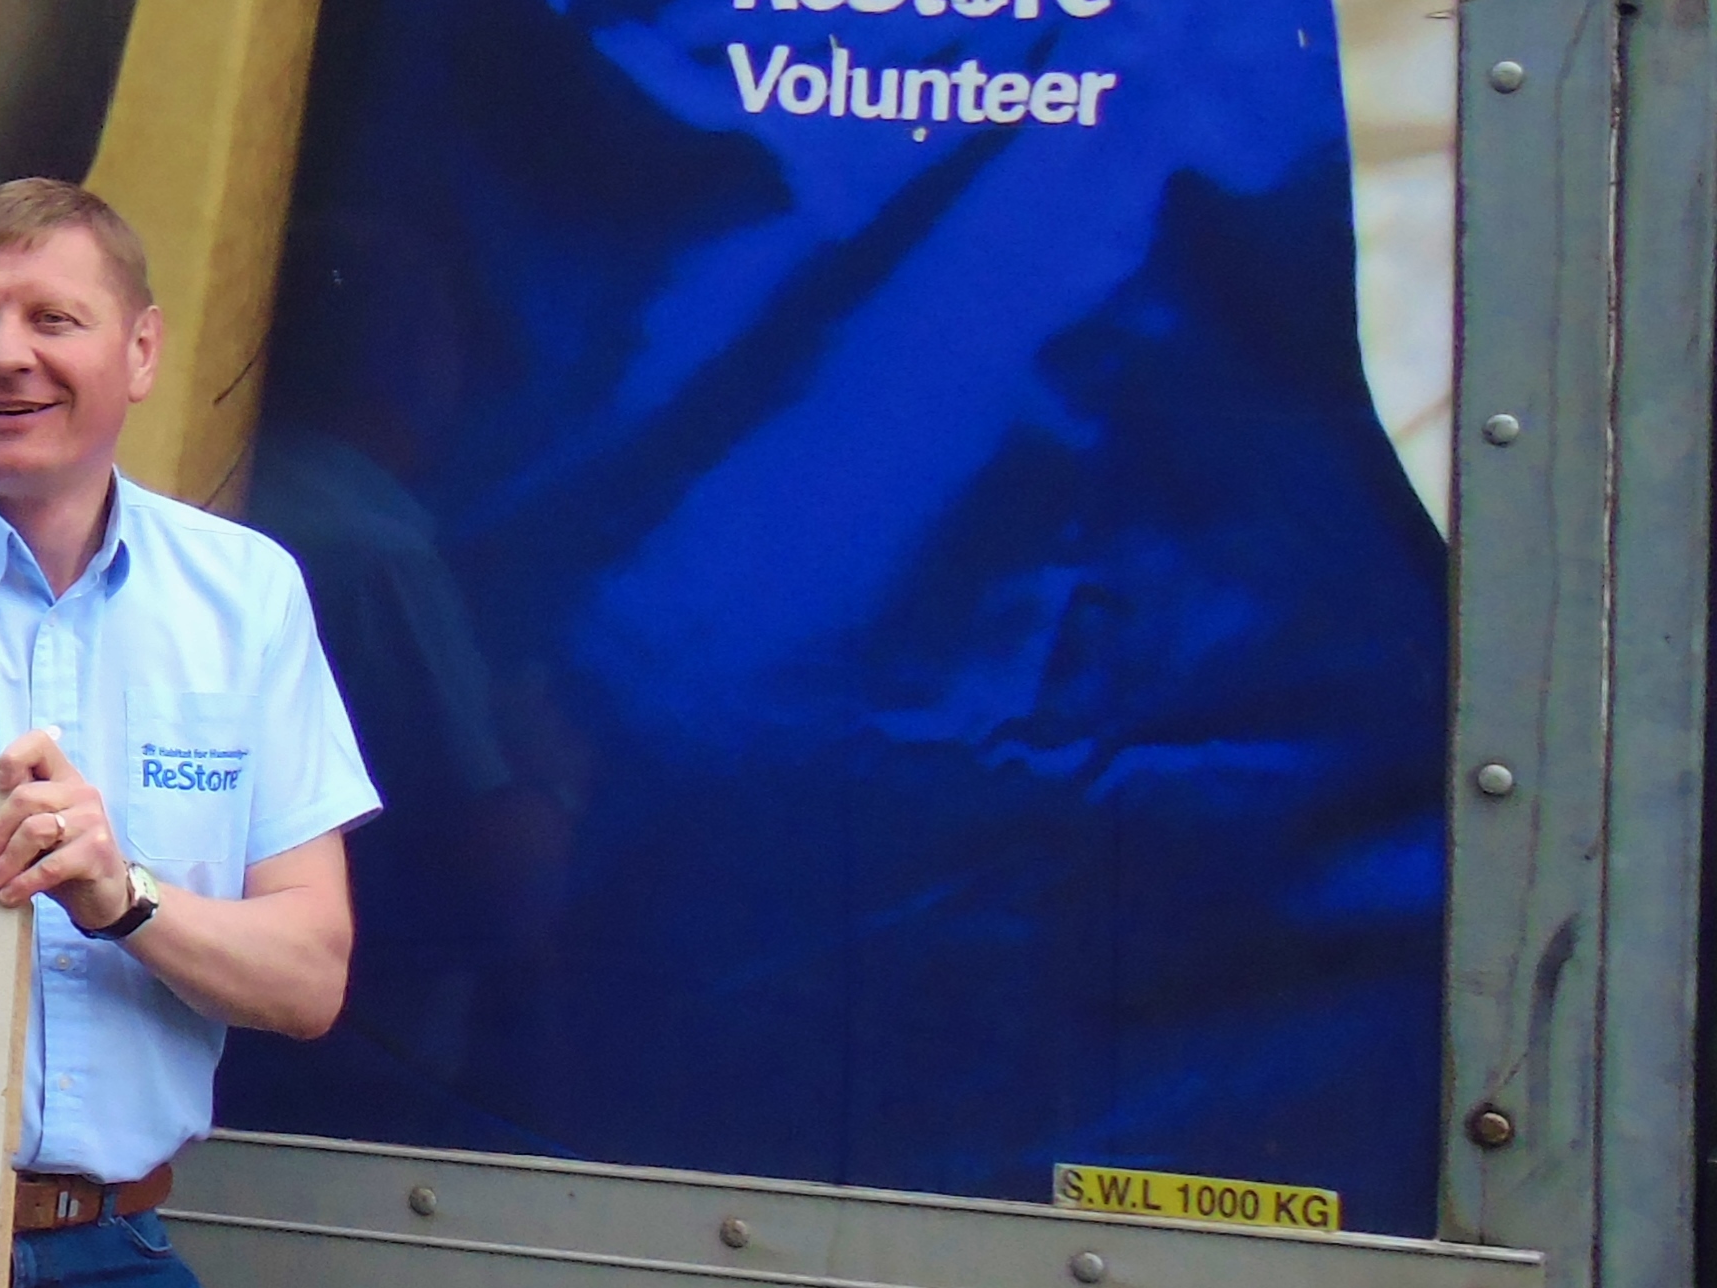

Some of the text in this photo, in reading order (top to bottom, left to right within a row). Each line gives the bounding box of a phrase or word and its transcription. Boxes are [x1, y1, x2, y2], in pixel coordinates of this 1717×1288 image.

[727, 43, 1116, 126] Volunteer
[142, 759, 240, 792] ReStore
[1062, 1170, 1329, 1227] S.W.L 1000 KG
